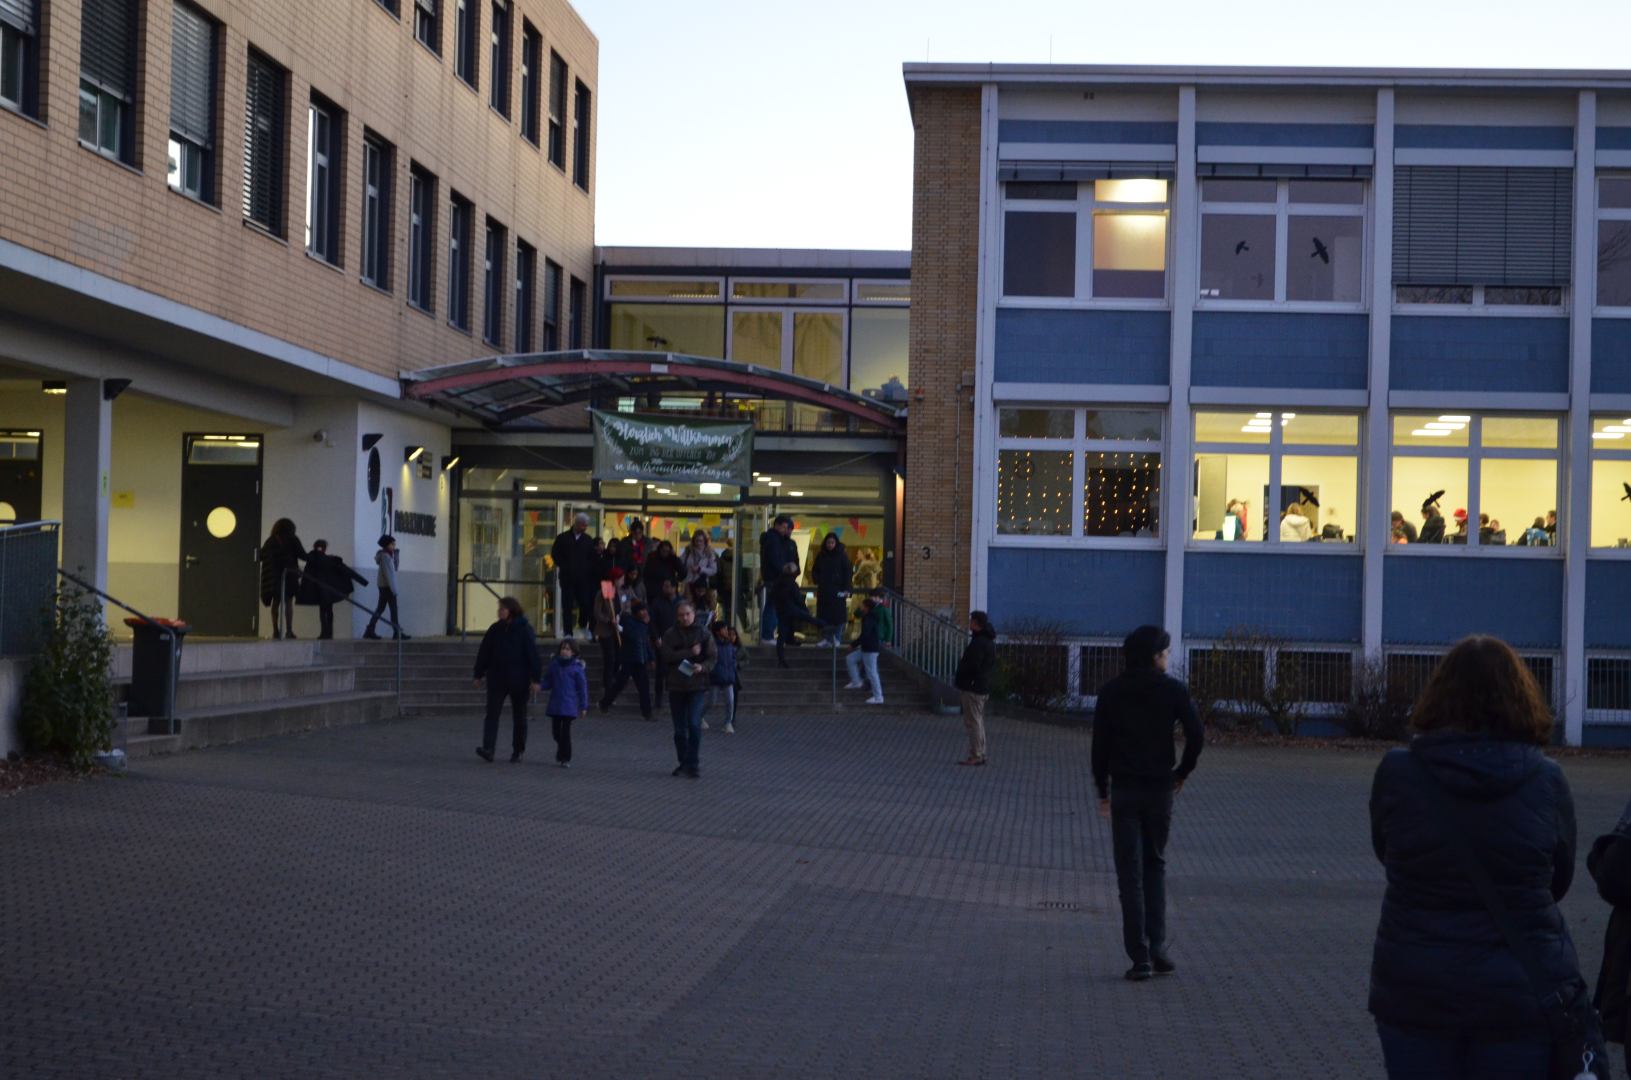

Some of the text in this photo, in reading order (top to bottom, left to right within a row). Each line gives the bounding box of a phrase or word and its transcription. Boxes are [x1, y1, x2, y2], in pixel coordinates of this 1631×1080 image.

[613, 421, 733, 447] Herzlich Willkommen
[922, 546, 931, 560] 3
